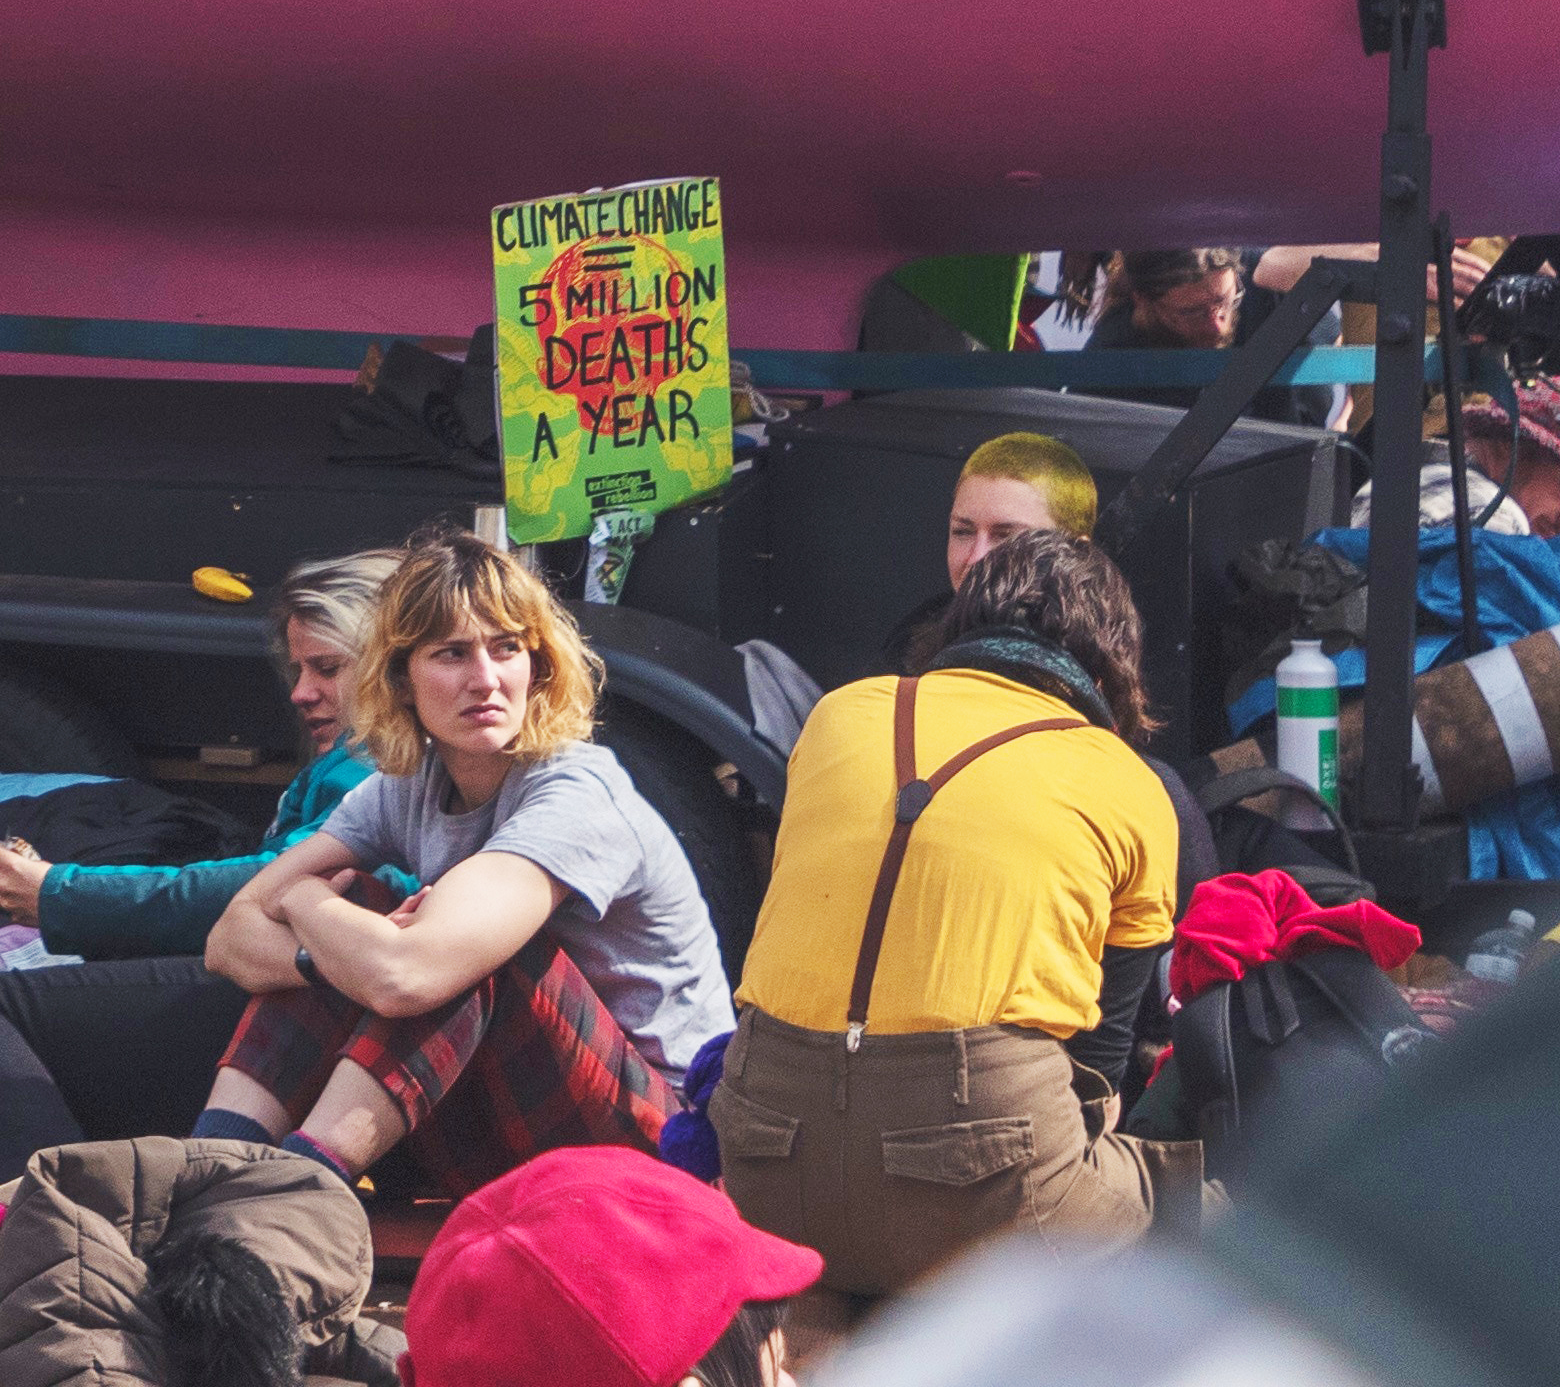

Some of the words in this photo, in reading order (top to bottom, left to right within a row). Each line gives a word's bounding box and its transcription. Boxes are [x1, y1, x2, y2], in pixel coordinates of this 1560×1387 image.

[518, 282, 553, 327] 5
[565, 264, 717, 321] MILLION
[544, 316, 710, 391] DEATHS
[532, 411, 559, 464] A
[582, 388, 700, 456] YEAR
